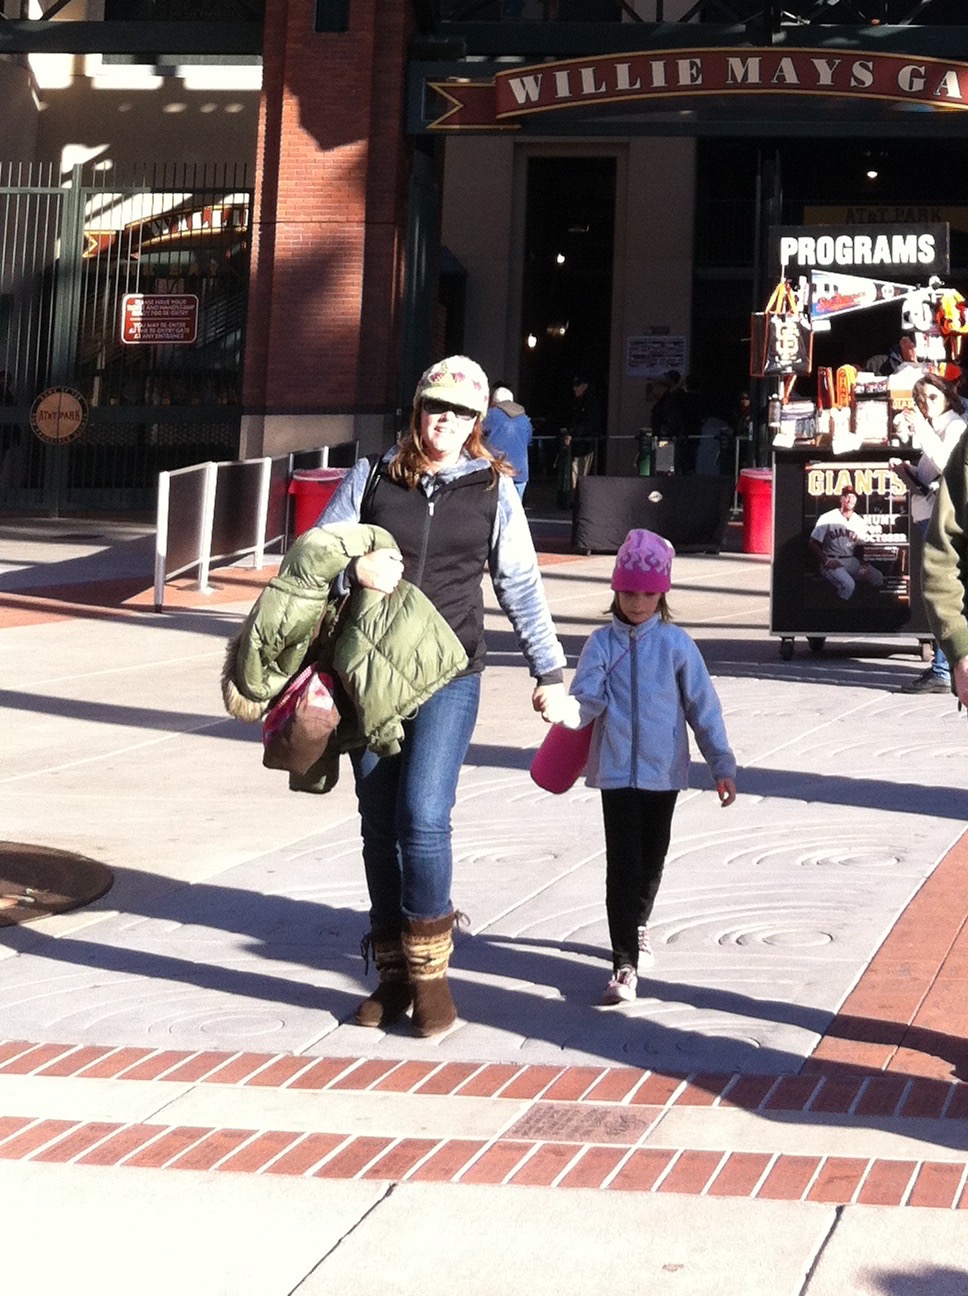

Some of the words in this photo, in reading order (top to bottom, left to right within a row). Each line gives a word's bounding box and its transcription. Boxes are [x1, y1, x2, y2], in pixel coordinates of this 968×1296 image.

[508, 58, 703, 104] WILLIE
[725, 57, 874, 88] MAYS
[780, 234, 936, 265] PROGRAMS
[808, 469, 907, 496] GIANTS
